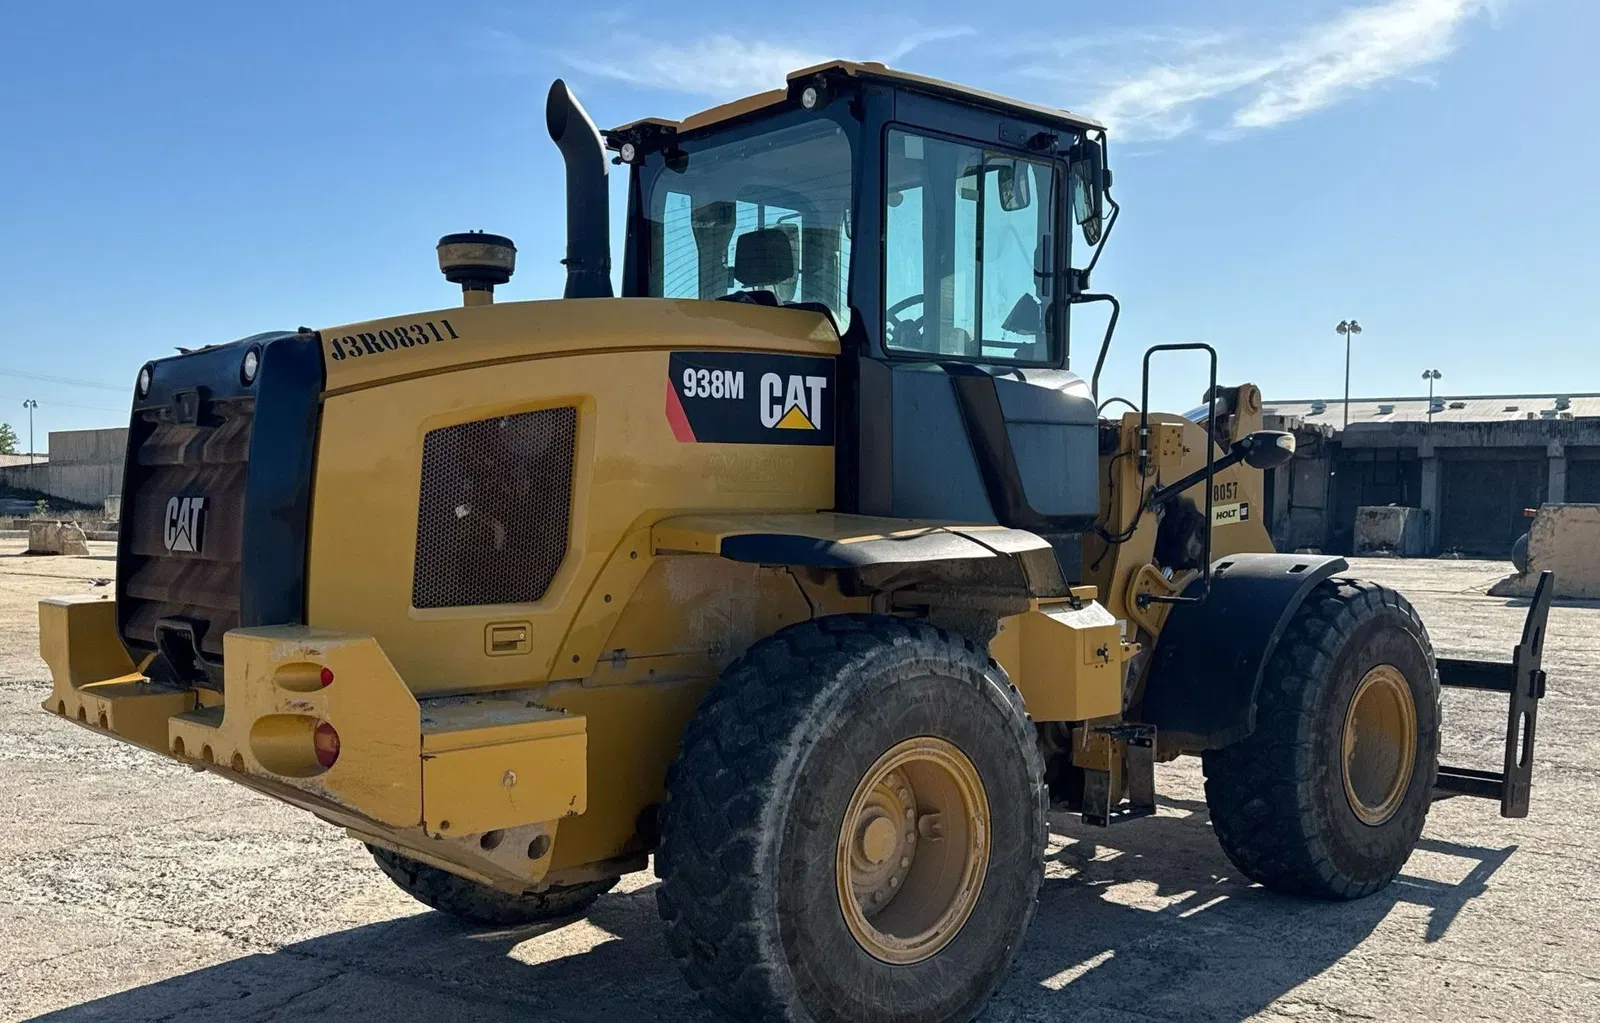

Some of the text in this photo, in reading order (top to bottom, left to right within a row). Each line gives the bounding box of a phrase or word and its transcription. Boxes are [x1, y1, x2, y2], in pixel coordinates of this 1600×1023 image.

[331, 320, 459, 360] J3R08311
[683, 368, 827, 430] 938M CAT
[1213, 482, 1238, 501] 8057
[164, 496, 205, 552] CAT
[1216, 509, 1238, 520] HOLT
